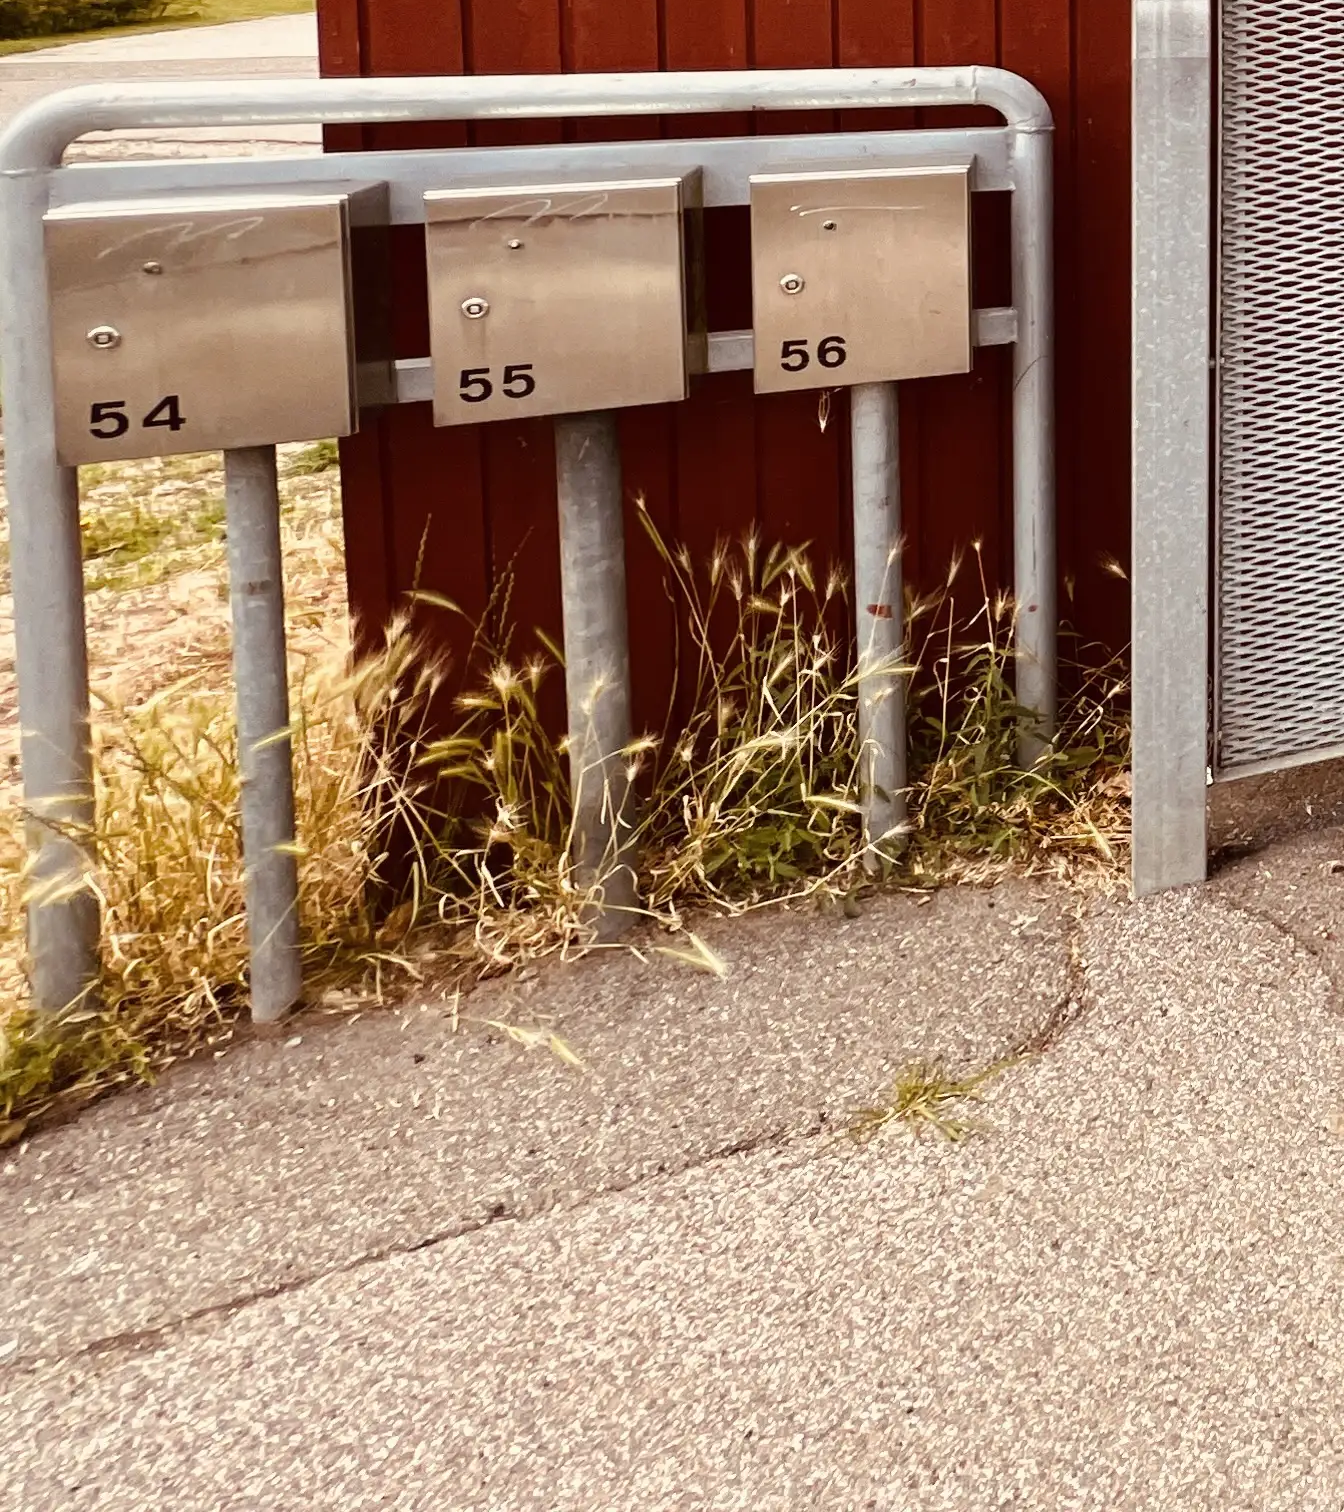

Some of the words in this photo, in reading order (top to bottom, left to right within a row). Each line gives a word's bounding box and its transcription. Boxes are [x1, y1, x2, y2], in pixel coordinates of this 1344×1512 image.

[780, 336, 848, 372] 56
[459, 364, 536, 403] 55
[89, 395, 187, 439] 54
